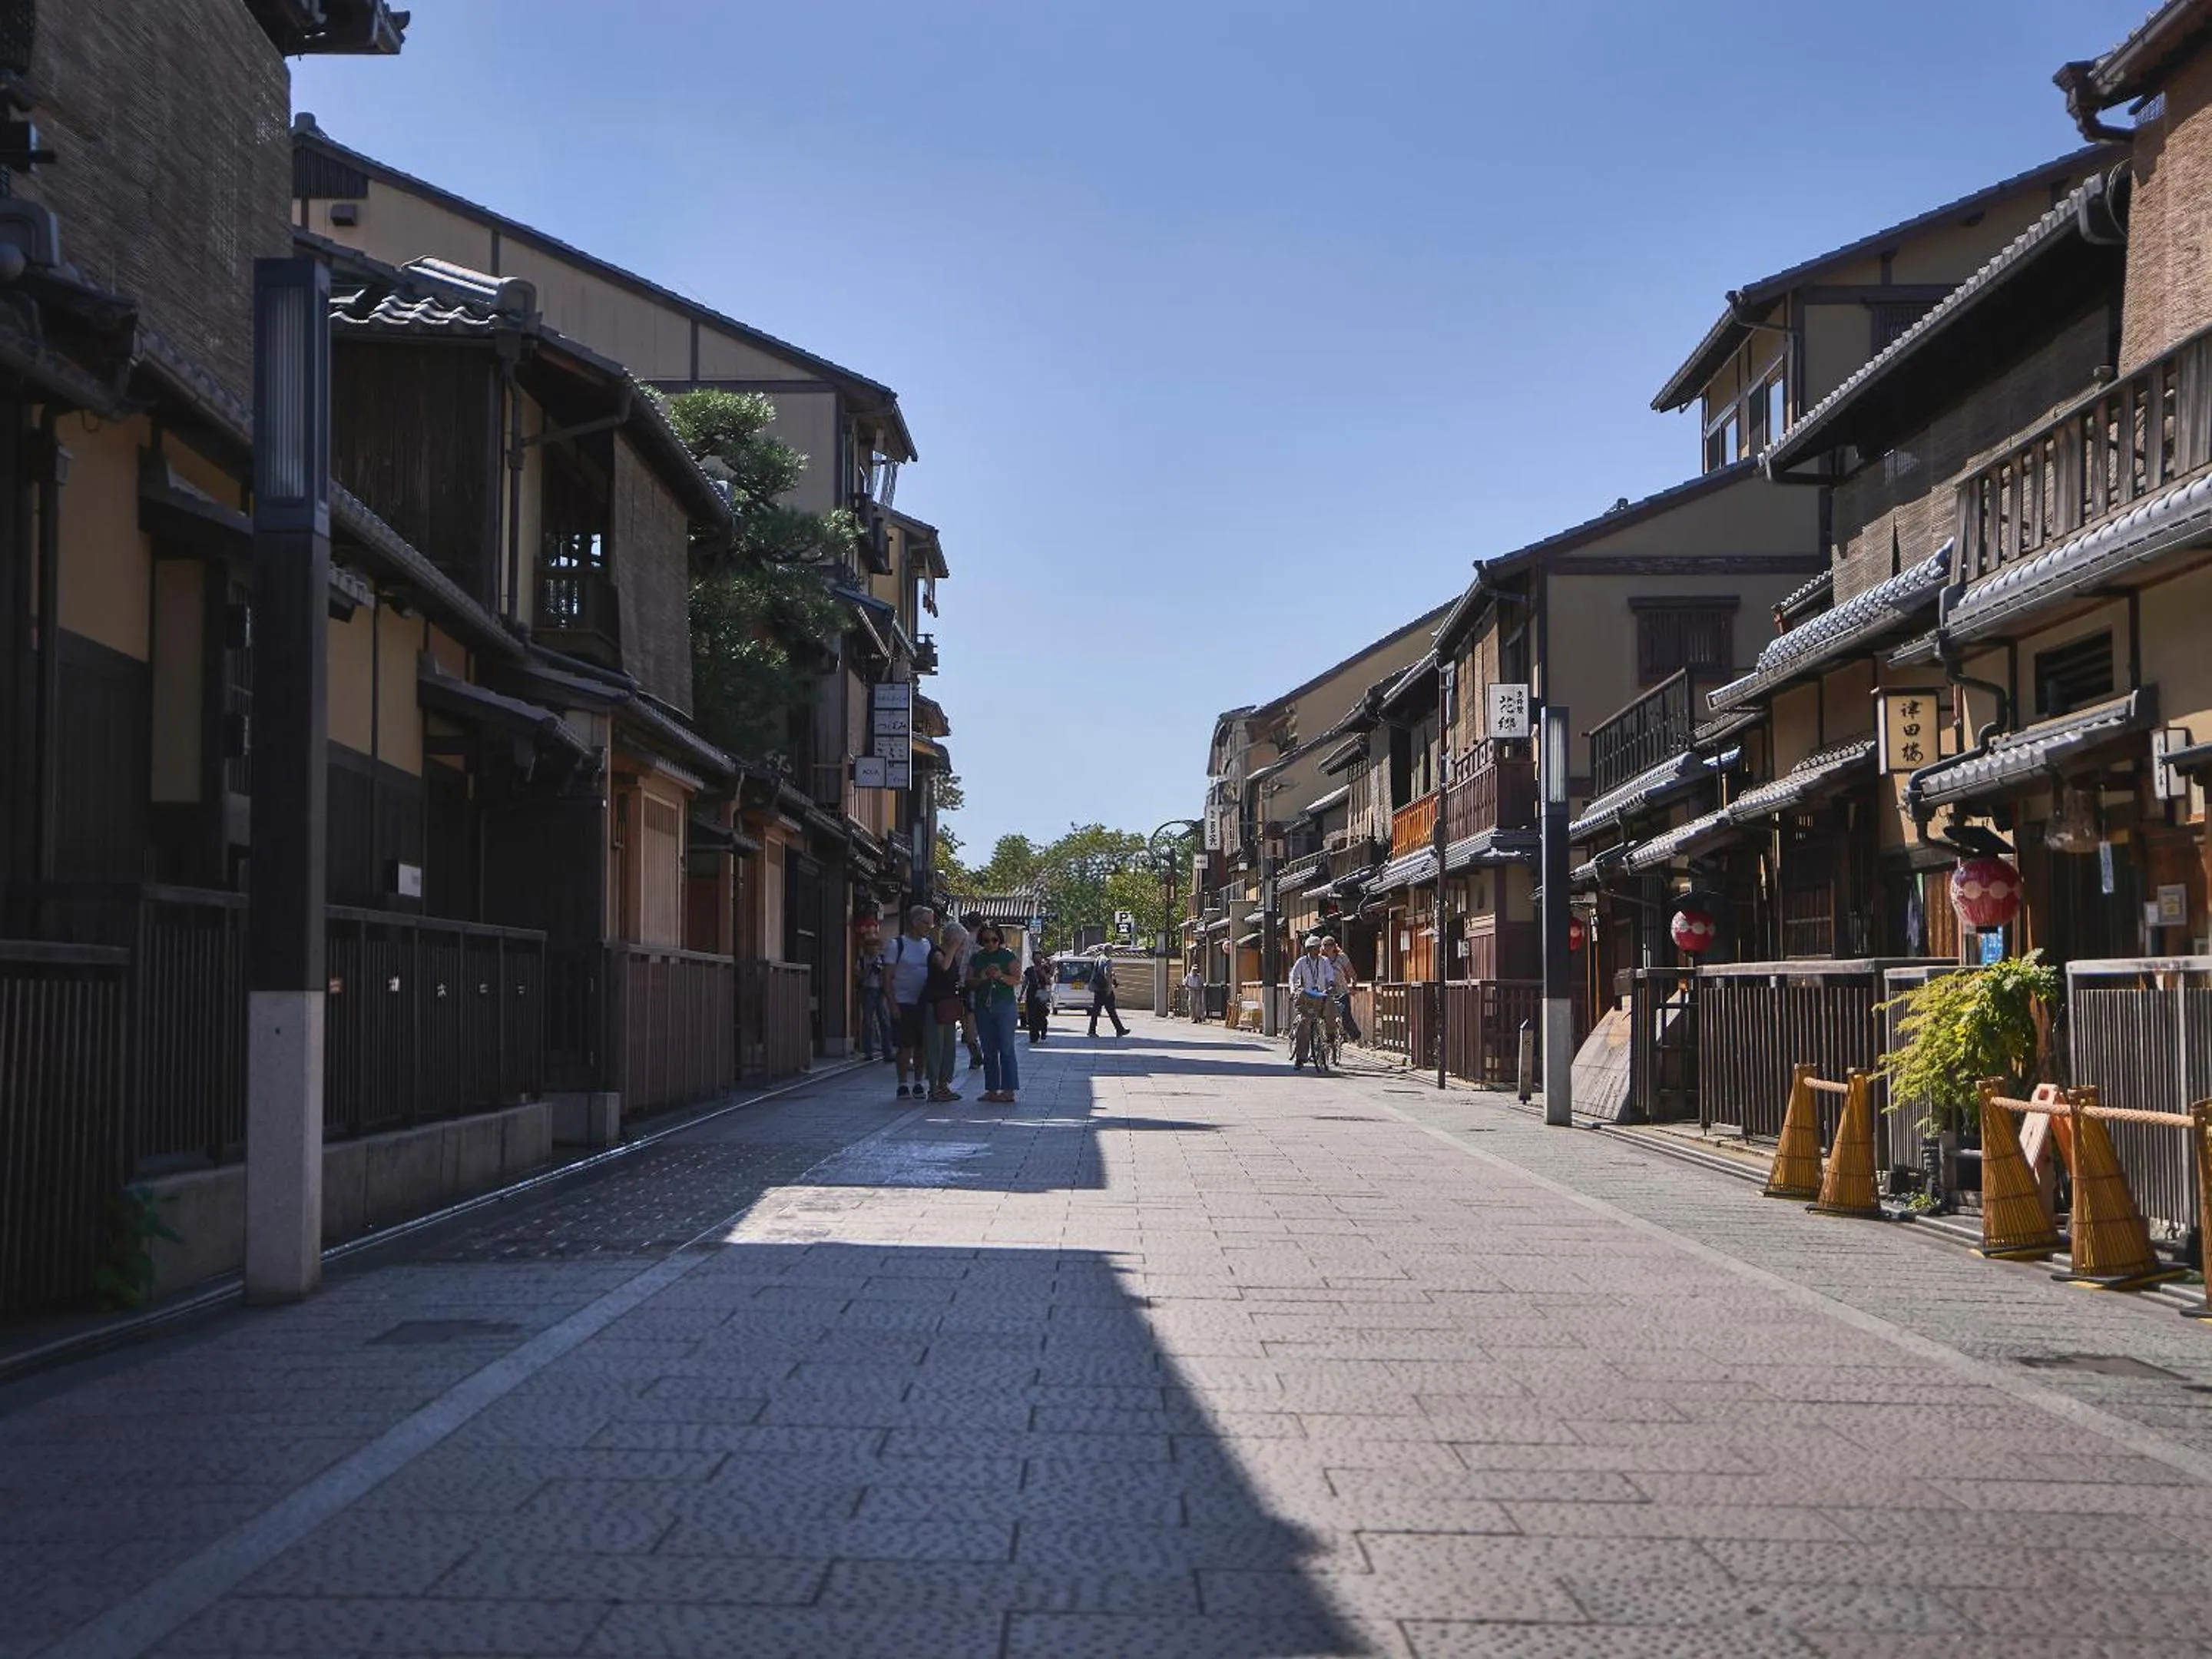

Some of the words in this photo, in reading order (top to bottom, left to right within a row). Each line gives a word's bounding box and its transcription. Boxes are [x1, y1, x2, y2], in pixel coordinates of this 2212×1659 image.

[1900, 700, 1924, 764] 津田楼
[1119, 912, 1128, 922] P
